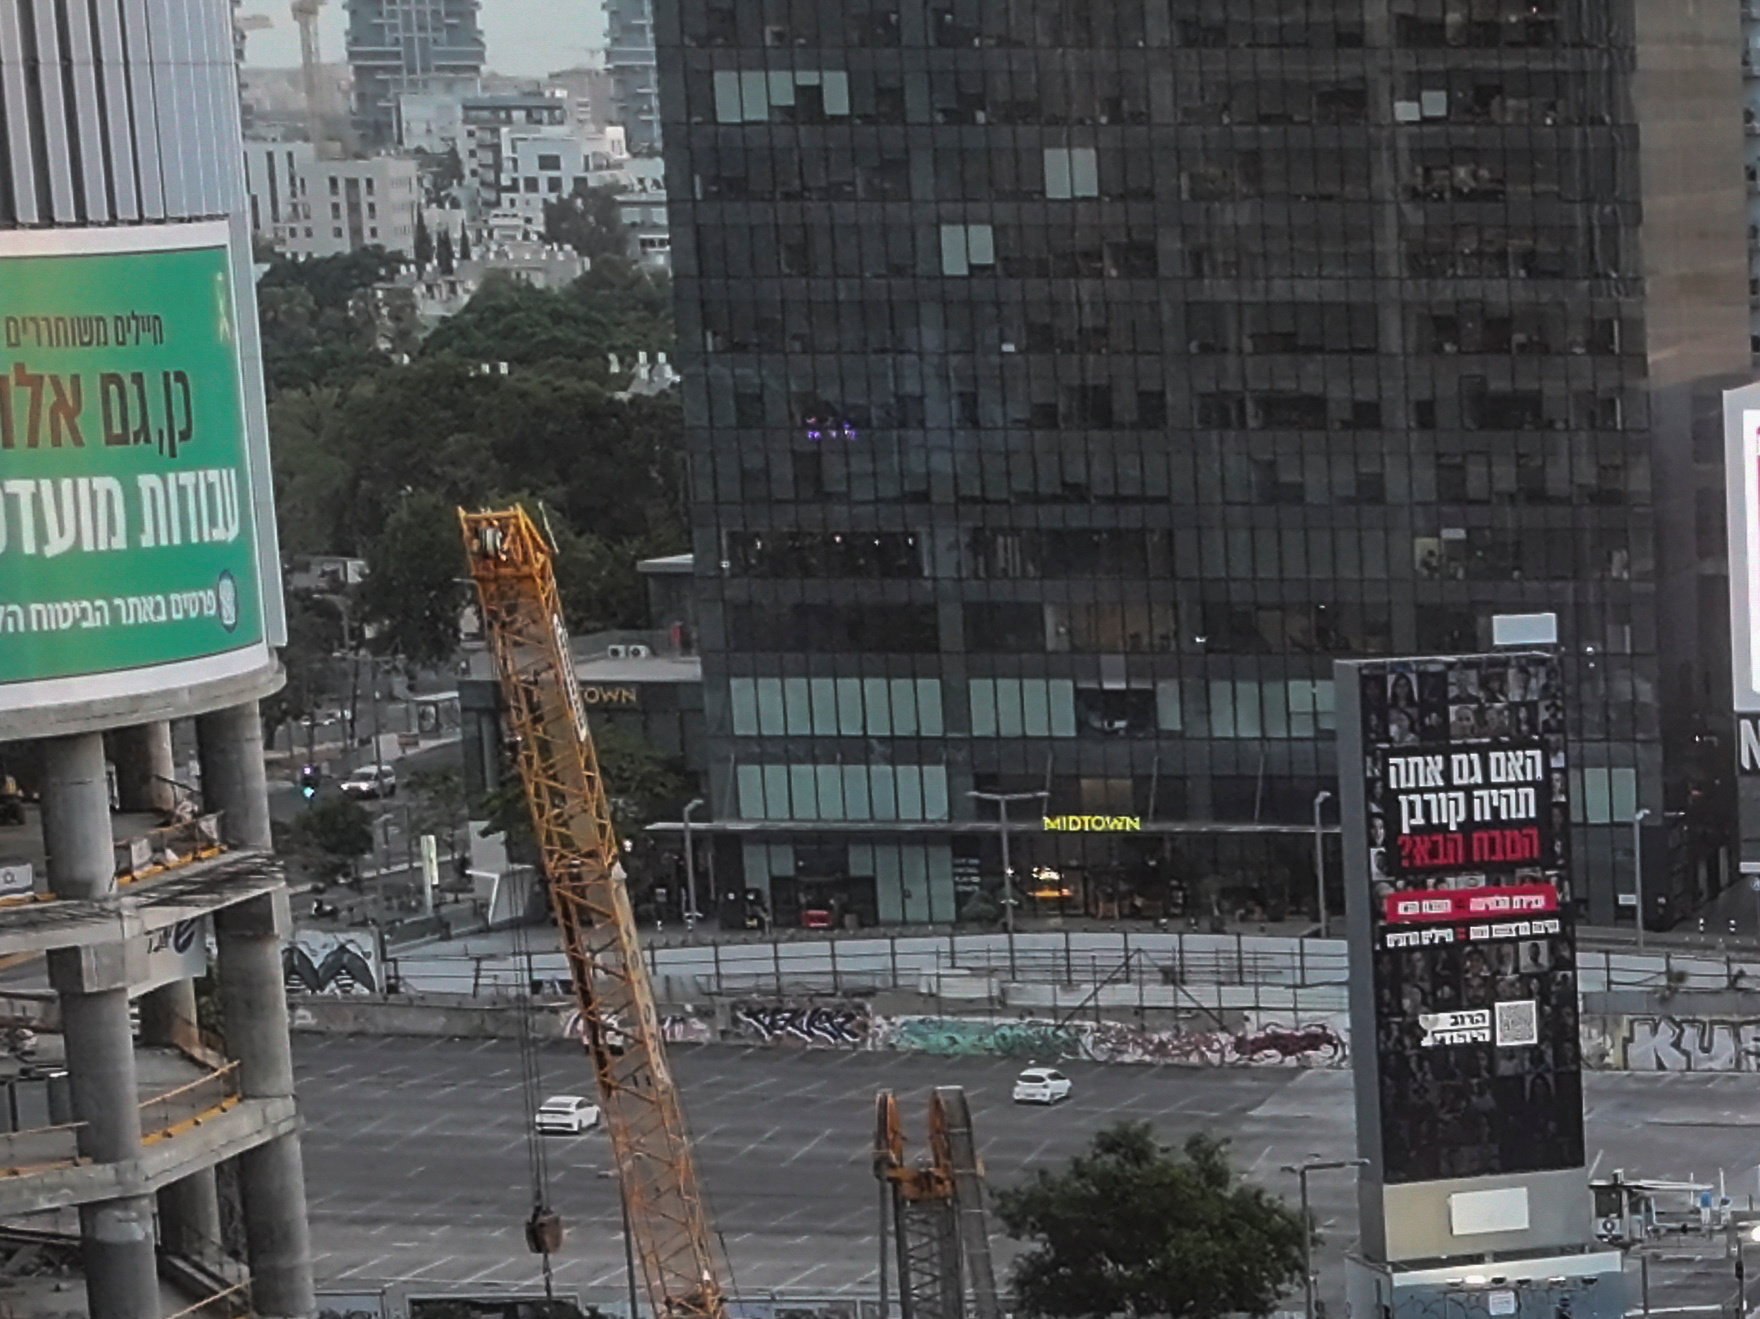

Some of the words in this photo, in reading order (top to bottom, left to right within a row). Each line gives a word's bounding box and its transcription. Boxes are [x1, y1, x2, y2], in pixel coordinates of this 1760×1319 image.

[5, 314, 109, 348] משוחררים
[114, 310, 164, 346] חיילים
[100, 371, 152, 446] גם
[137, 469, 240, 548] עבודות
[30, 599, 109, 632] הביטוח
[113, 594, 166, 625] באתר
[170, 588, 217, 621] פרטים
[1389, 755, 1445, 789] אתה
[1451, 753, 1483, 786] גם
[1489, 749, 1543, 784] האם
[1398, 791, 1466, 834] קורבן
[1473, 787, 1537, 822] תהיה
[1043, 815, 1141, 831] MIDTOWN
[1397, 833, 1464, 867] הבא?
[1472, 827, 1540, 864] הטבח
